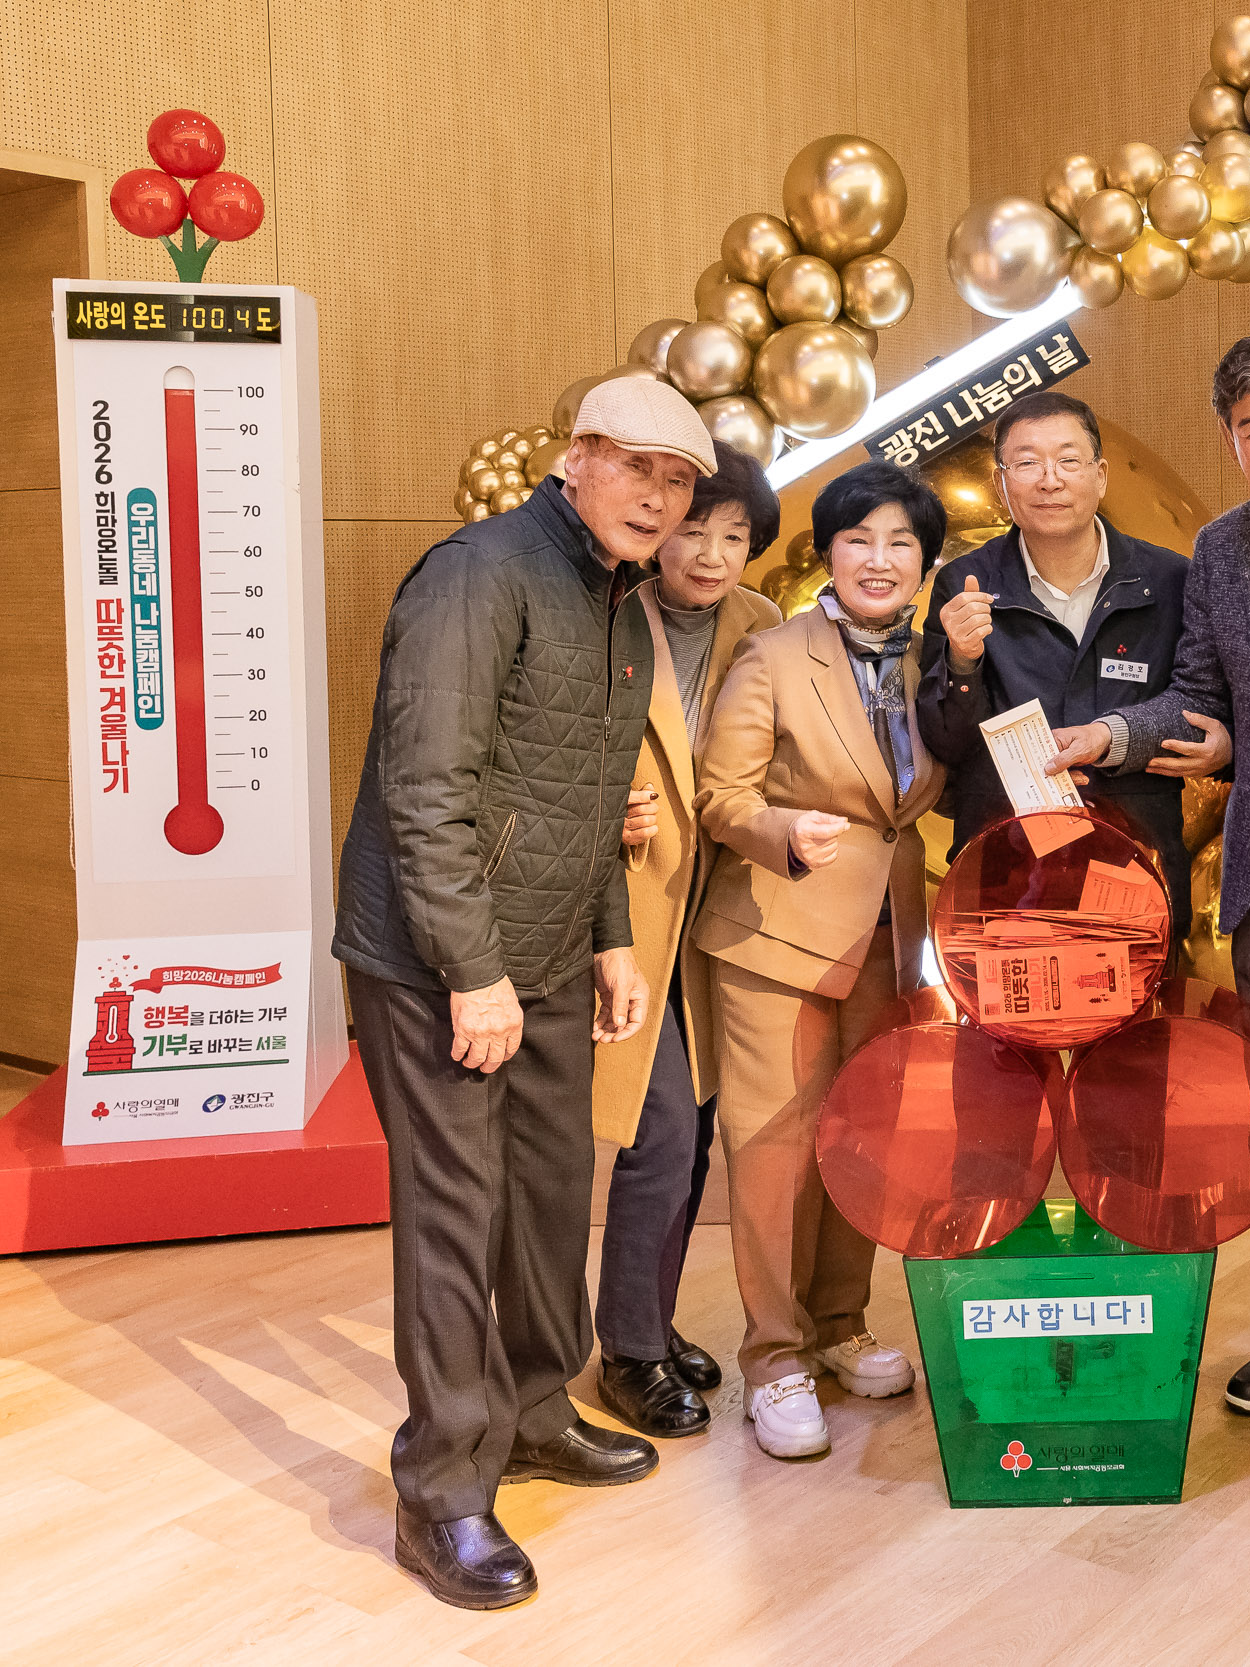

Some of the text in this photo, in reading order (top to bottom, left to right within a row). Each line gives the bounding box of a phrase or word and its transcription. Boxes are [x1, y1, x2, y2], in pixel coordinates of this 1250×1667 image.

[76, 301, 126, 329] 사랑의
[133, 304, 166, 330] 온도
[237, 386, 264, 398] 100
[878, 332, 1078, 467] 광진 나눔의 날
[239, 424, 258, 436] 90
[241, 464, 260, 477] 80
[242, 506, 261, 518] 70
[244, 546, 262, 558] 60
[92, 399, 130, 794] 2026 희망온돌 따뜻한 겨울나기
[245, 586, 264, 598] 50
[130, 502, 162, 719] 우리동네 나눔캠페인
[246, 628, 265, 639] 40
[248, 668, 266, 680] 30
[249, 710, 267, 722] 20
[250, 746, 268, 759] 10
[251, 780, 260, 791] 0
[162, 970, 266, 986] 희망2026나눔캠페인
[1010, 957, 1029, 1013] 따뜻한
[144, 1005, 288, 1028] 행복을 더하는 기부
[142, 1034, 287, 1057] 기부로 바꾸는 서울
[230, 1092, 274, 1104] 광진구
